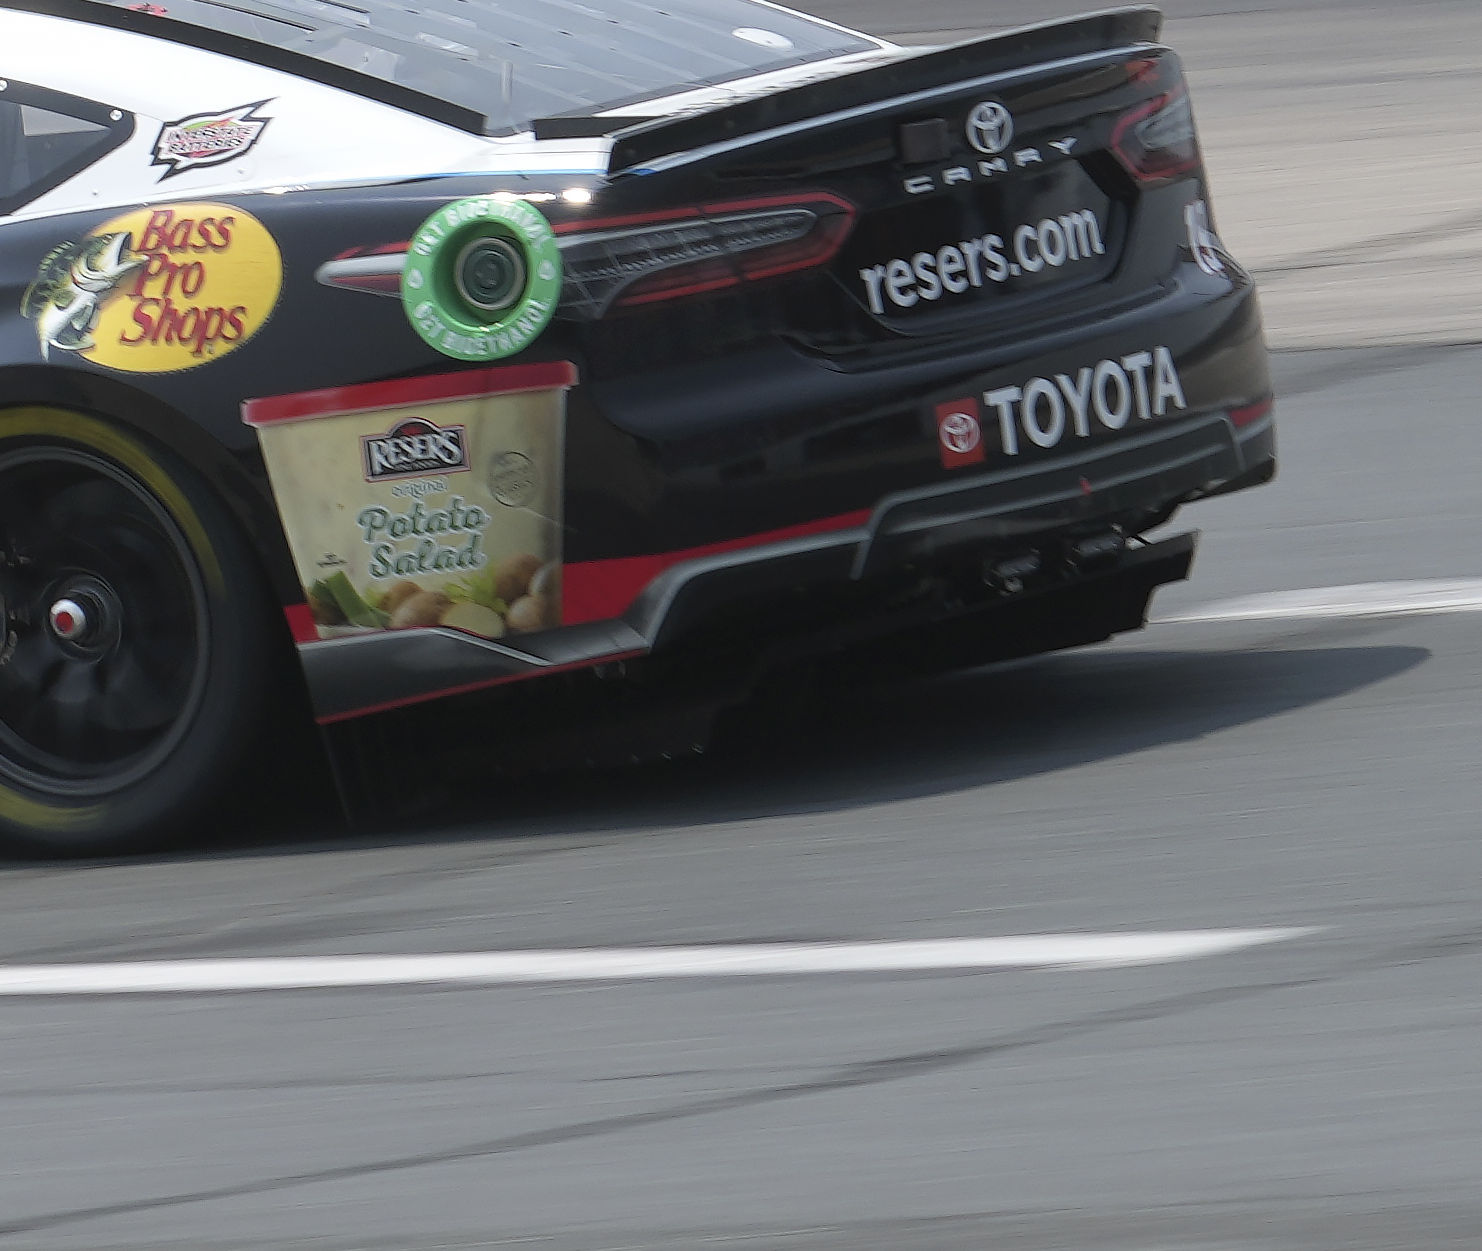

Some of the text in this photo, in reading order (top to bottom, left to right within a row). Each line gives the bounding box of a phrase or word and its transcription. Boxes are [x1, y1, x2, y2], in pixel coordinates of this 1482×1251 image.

[903, 136, 1078, 194] CAMRY
[134, 209, 236, 254] Bass
[129, 253, 205, 300] Pro
[859, 208, 1105, 316] resers.com
[119, 297, 247, 357] Shops
[982, 345, 1187, 456] TOYOTA
[355, 495, 492, 544] Potato
[367, 531, 488, 581] Salad
